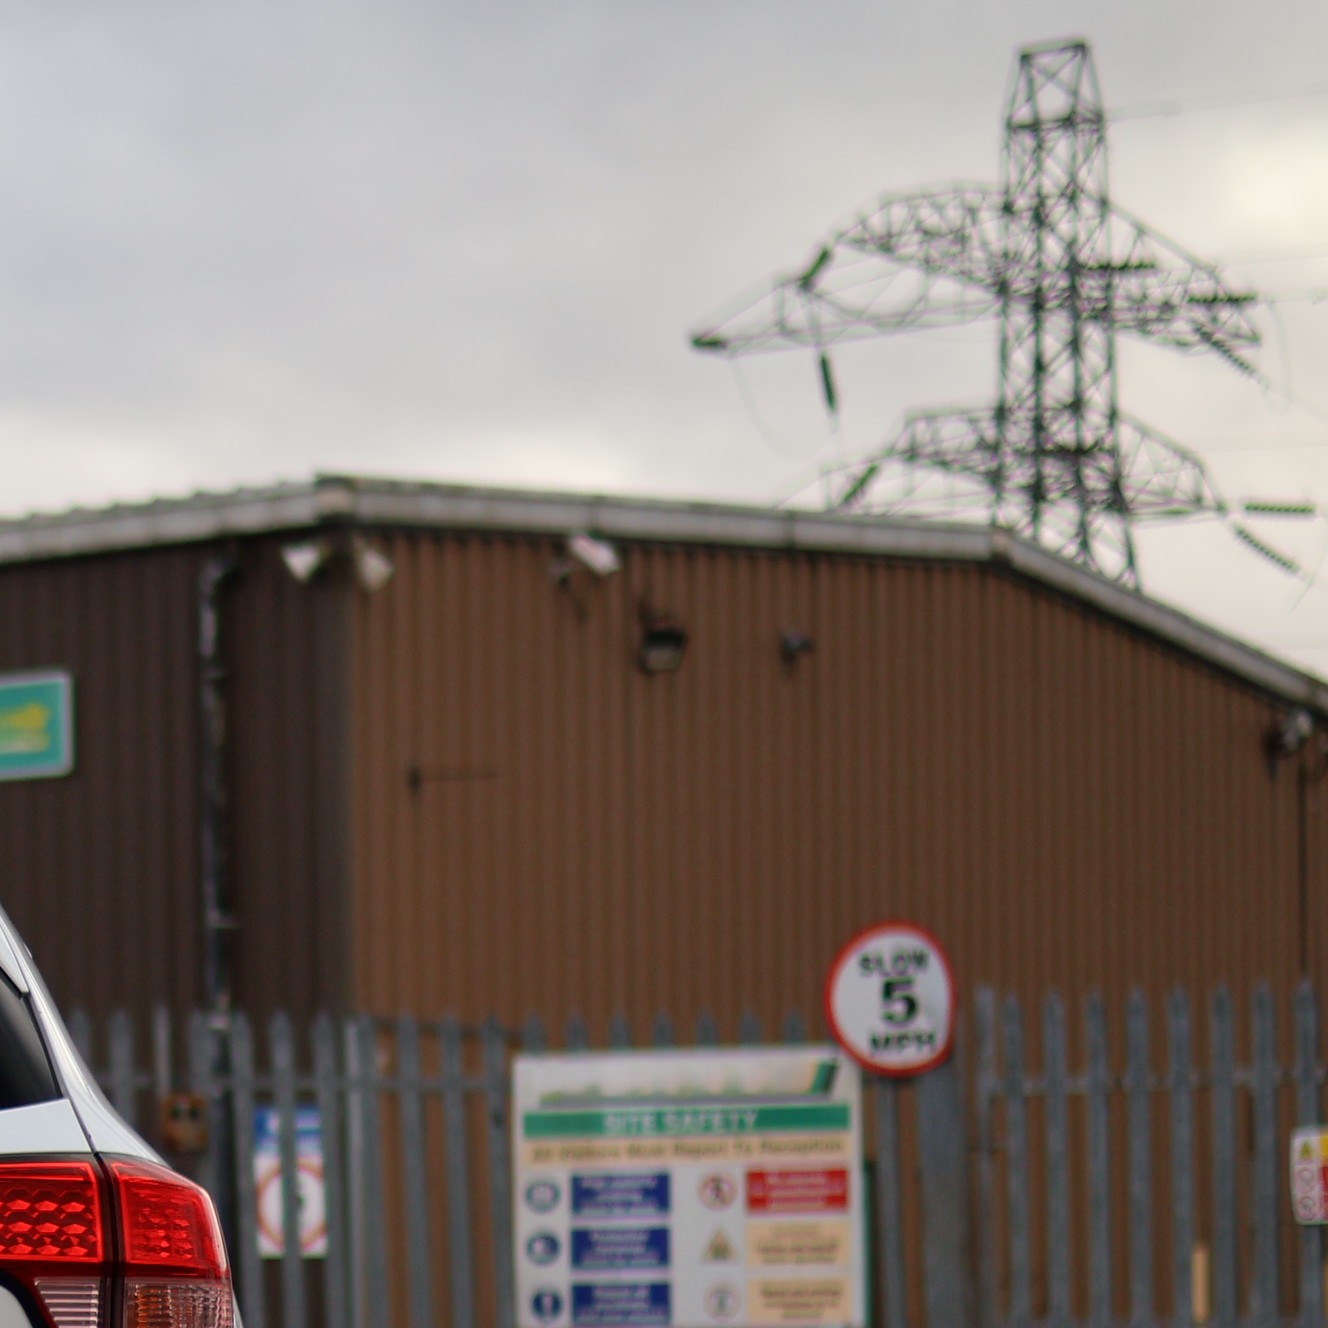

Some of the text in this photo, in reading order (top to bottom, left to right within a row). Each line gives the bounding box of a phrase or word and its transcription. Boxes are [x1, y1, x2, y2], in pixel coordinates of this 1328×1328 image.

[859, 949, 929, 977] SLOW
[882, 977, 917, 1024] 5
[870, 1031, 936, 1055] MPH
[604, 1108, 759, 1134] SITE SAFETY
